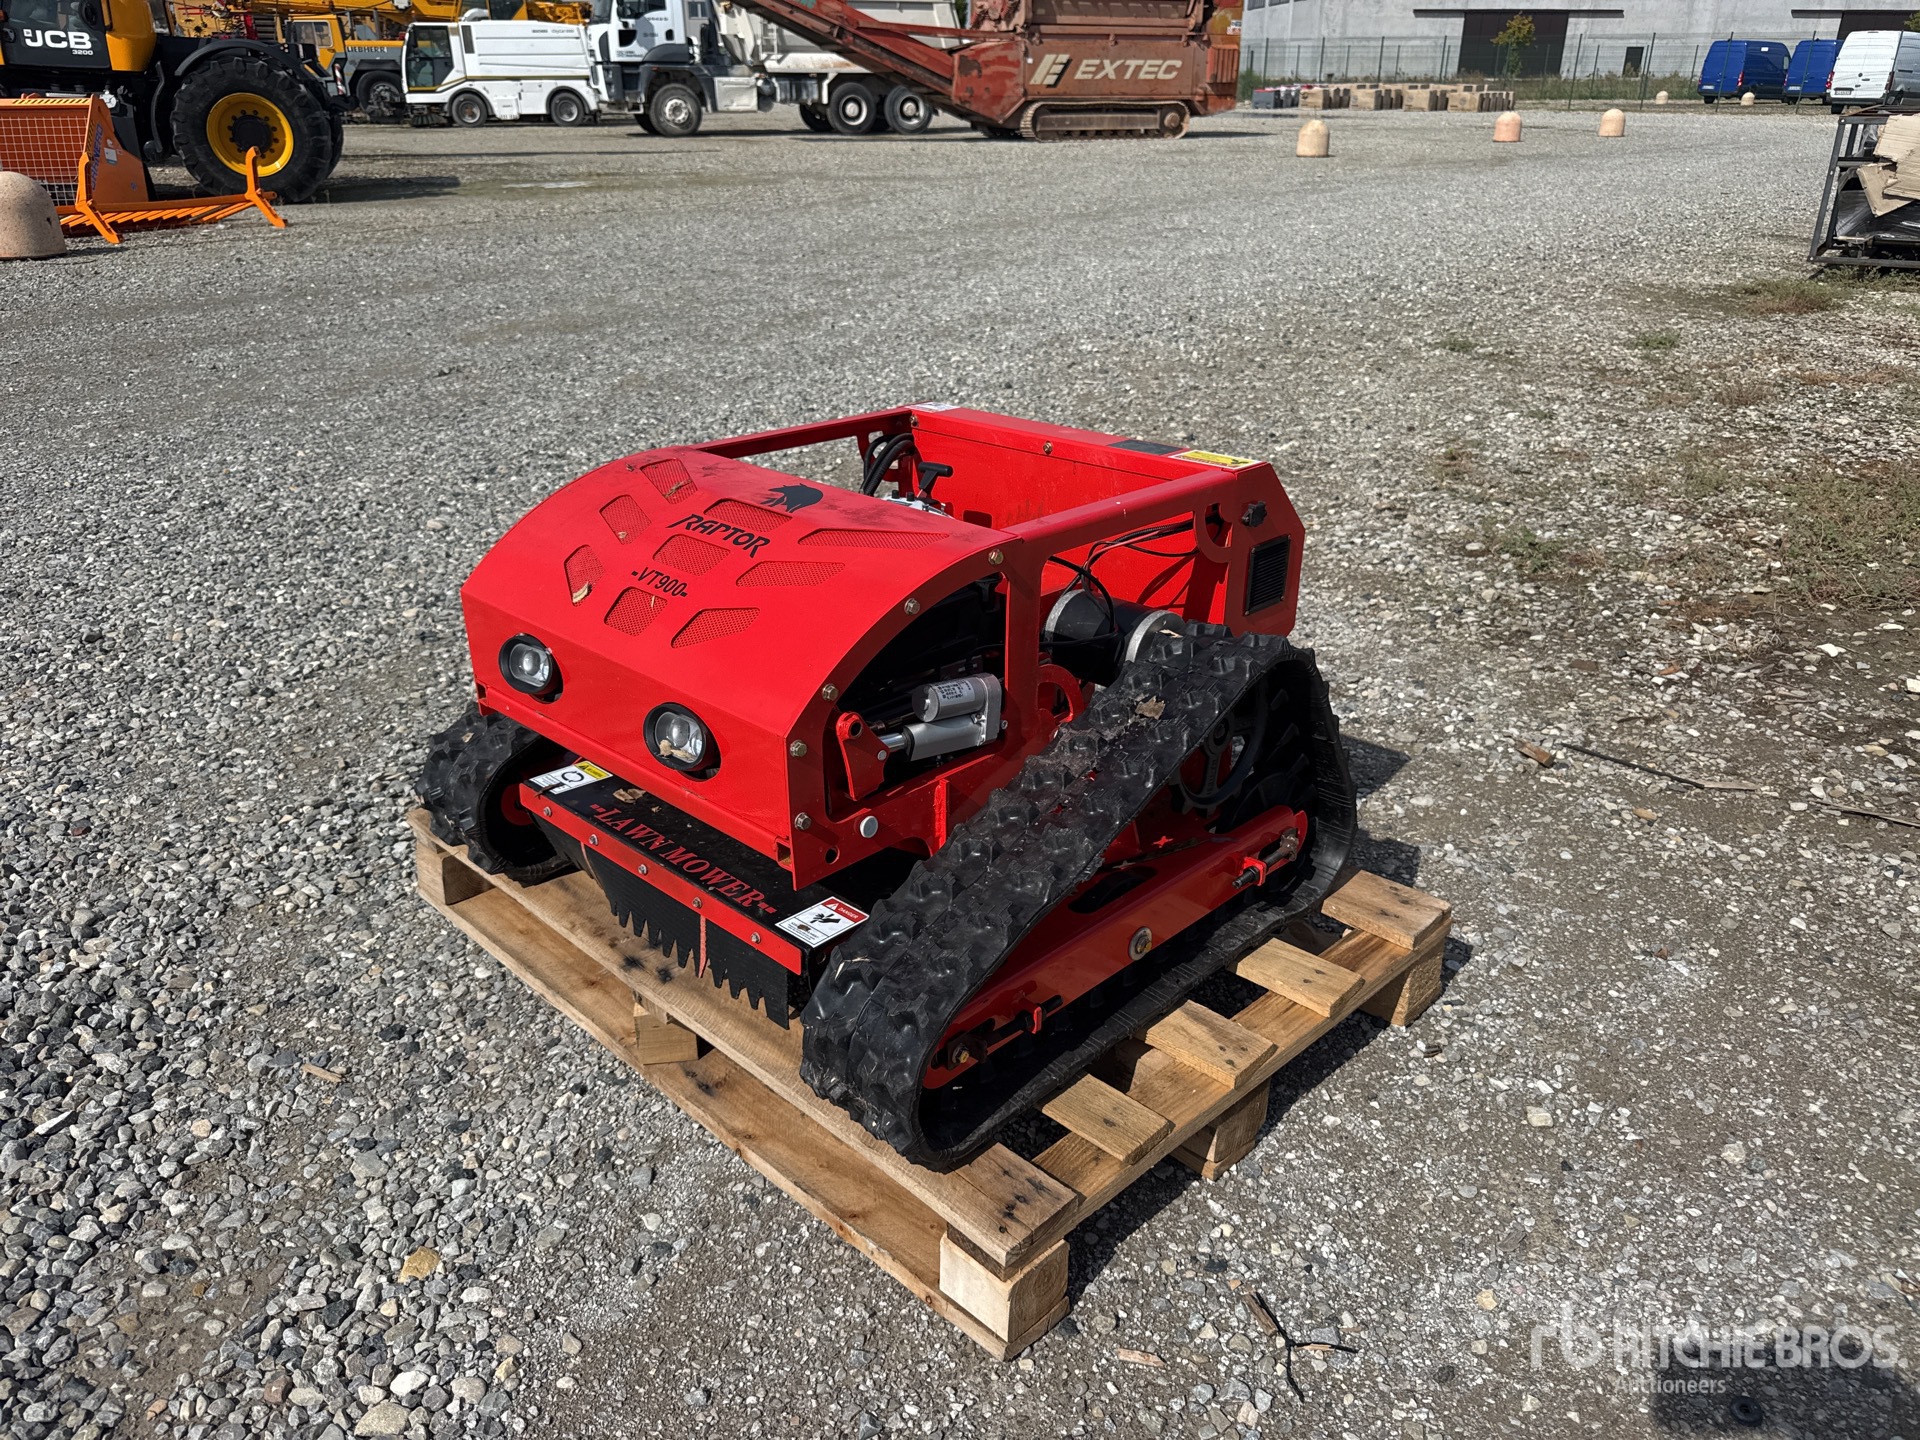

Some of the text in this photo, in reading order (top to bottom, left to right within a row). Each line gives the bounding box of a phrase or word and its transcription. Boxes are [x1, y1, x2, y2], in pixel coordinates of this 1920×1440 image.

[22, 28, 92, 49] JCB
[1073, 59, 1183, 80] EXTEC
[666, 513, 771, 559] RAPTOR
